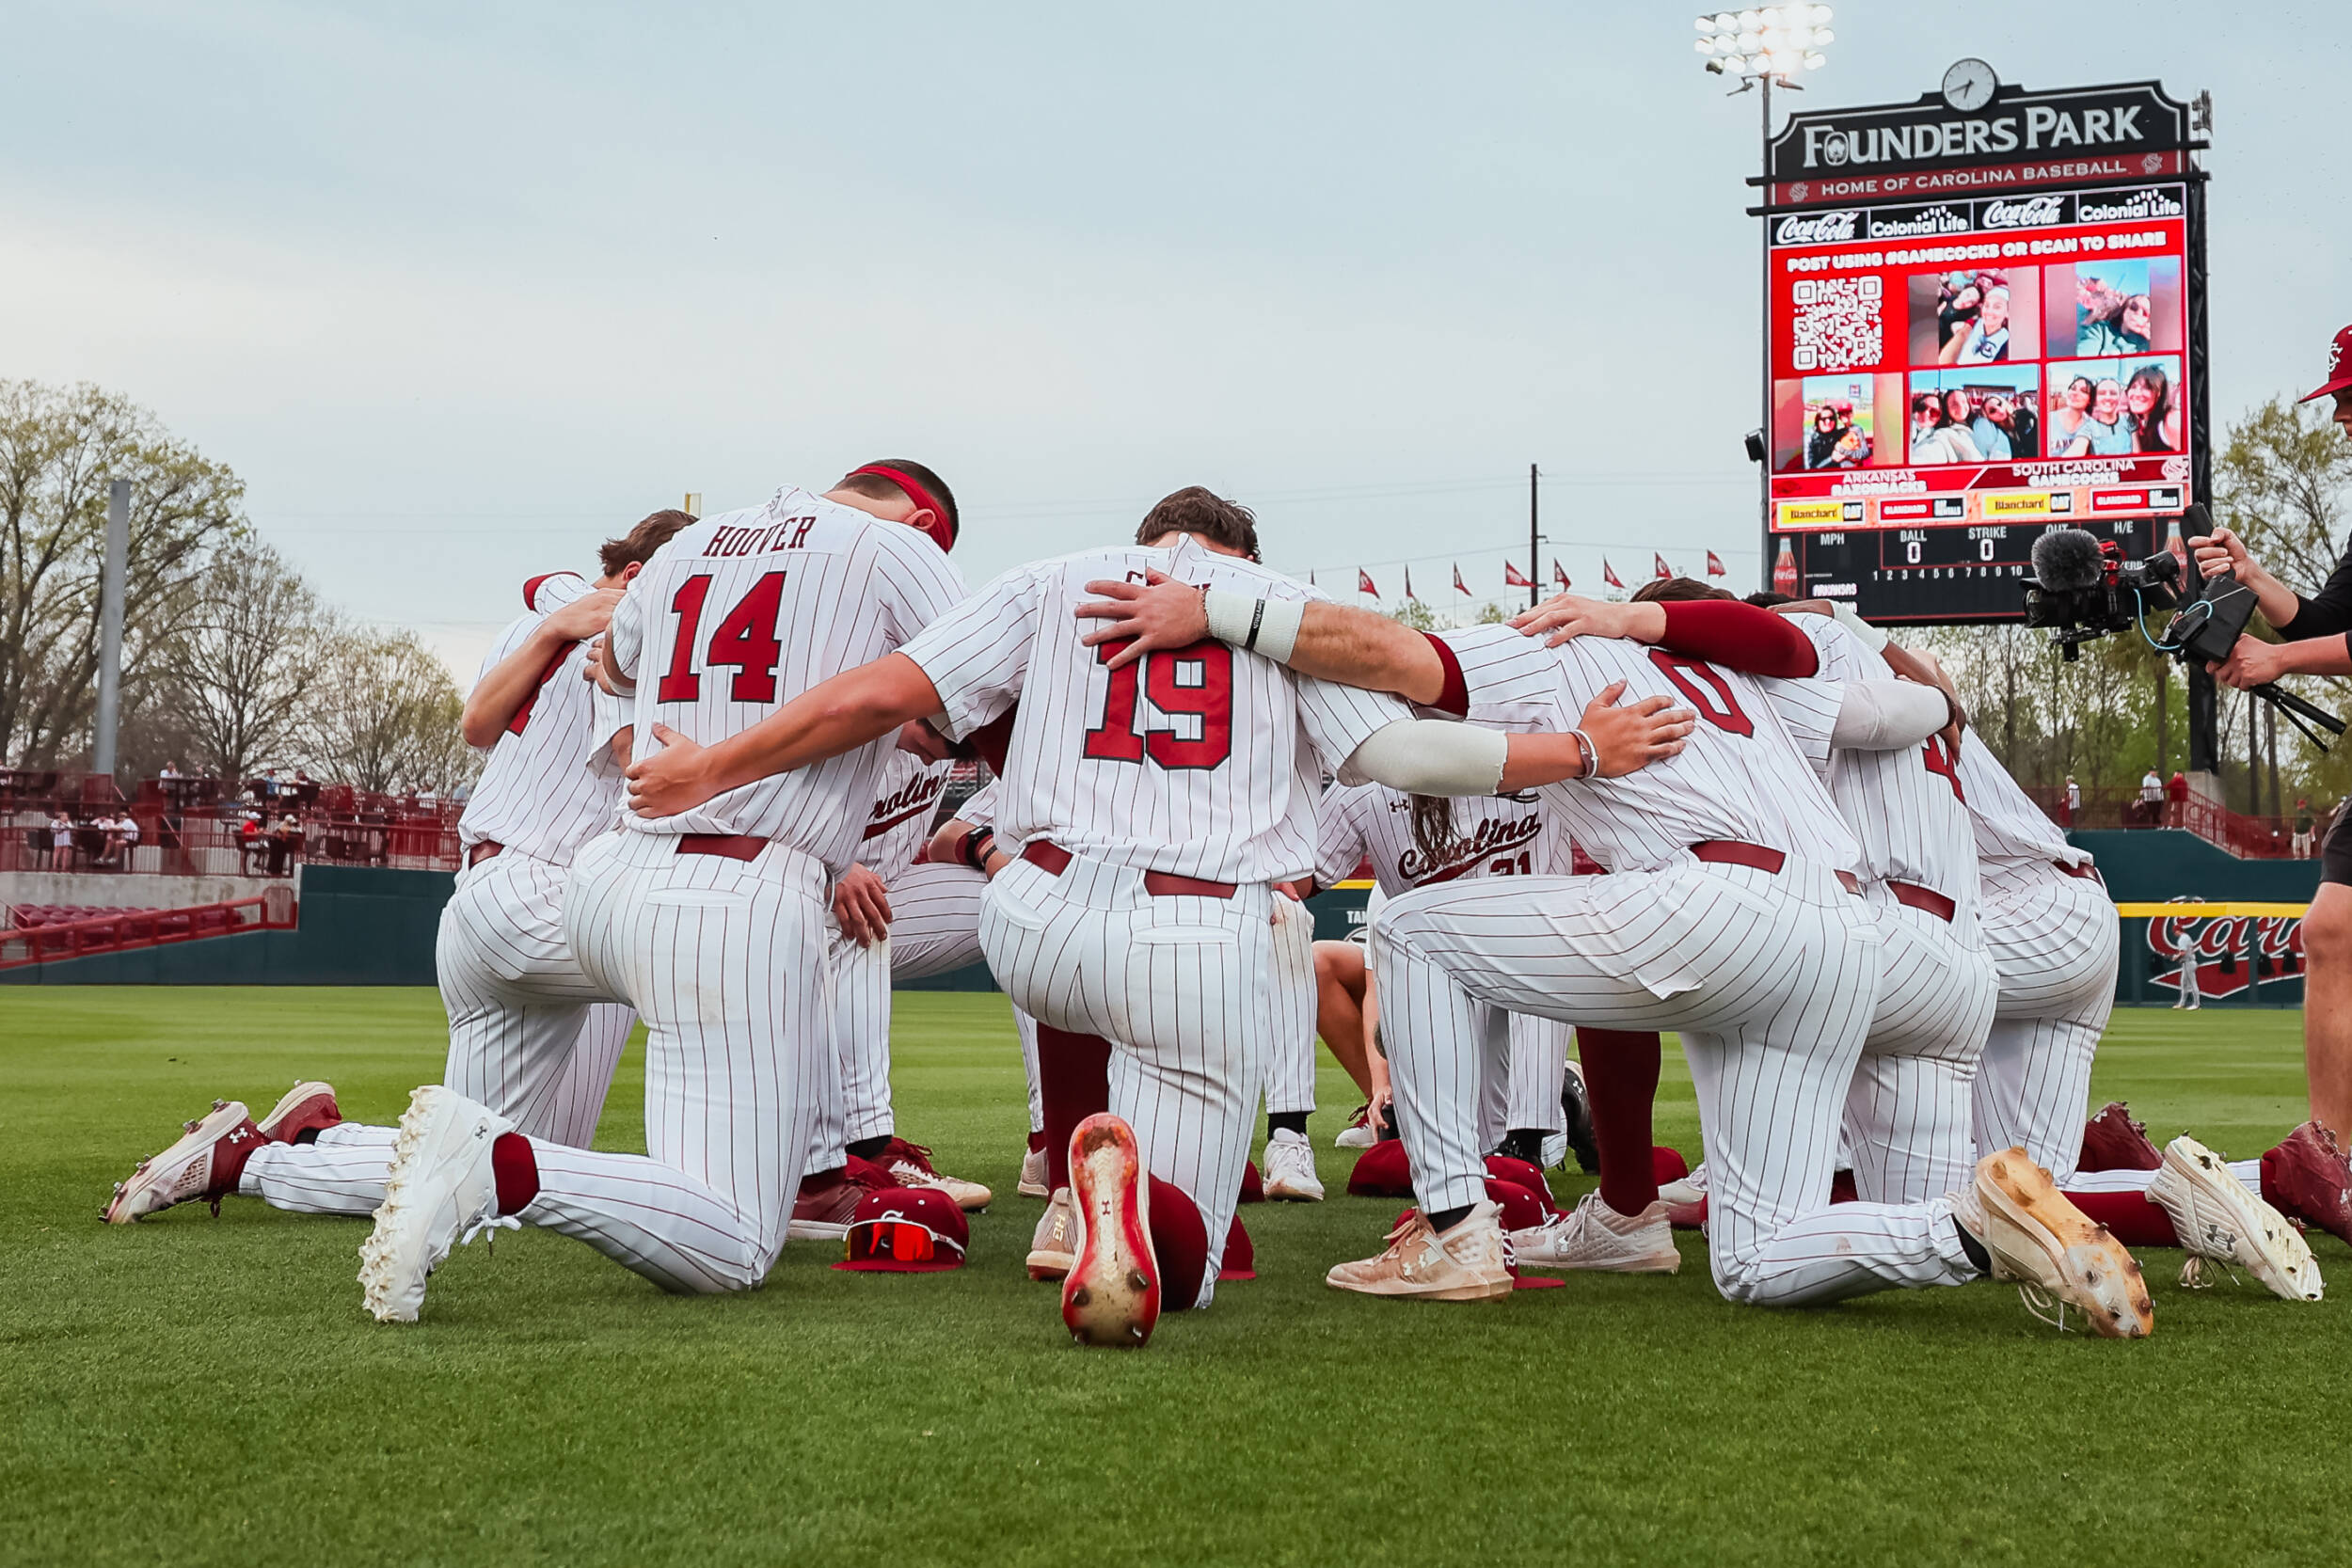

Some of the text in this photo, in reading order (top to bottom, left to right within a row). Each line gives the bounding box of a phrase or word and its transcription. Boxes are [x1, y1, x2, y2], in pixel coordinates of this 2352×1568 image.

[1803, 105, 2144, 167] FOUNDERS PARK
[1821, 180, 1878, 196] HOME
[1883, 177, 1910, 191] OF
[1915, 169, 2015, 188] CAROLINA
[2023, 161, 2127, 181] BASEBALL
[2079, 198, 2182, 222] Colonial Life
[1870, 214, 1969, 237] Colonial Life
[1787, 231, 2166, 272] POST USING #GAMECOCKS OR SCAN TO SHARE
[1843, 470, 1916, 484] ARKANSAS
[2012, 459, 2136, 477] SOUTH CAROLINA
[2027, 472, 2120, 487] GAMECOCKS
[703, 516, 817, 557] HOOVER
[1820, 533, 1845, 546] MPH
[1900, 530, 1927, 543] BALL
[1968, 526, 2007, 540] STRIKE
[2114, 520, 2134, 534] H/E
[1907, 542, 1921, 563] 0
[1979, 539, 1994, 562] 0
[1873, 570, 1879, 581] 1
[1886, 569, 1893, 580] 2
[1902, 569, 1908, 580] 3
[1919, 568, 1925, 579] 4
[1947, 567, 1954, 578] 6
[1966, 567, 1972, 578] 7
[1980, 566, 1987, 577] 8
[1994, 566, 2002, 577] 9
[2010, 565, 2023, 576] 10
[657, 571, 787, 705] 14
[1082, 637, 1233, 770] 19
